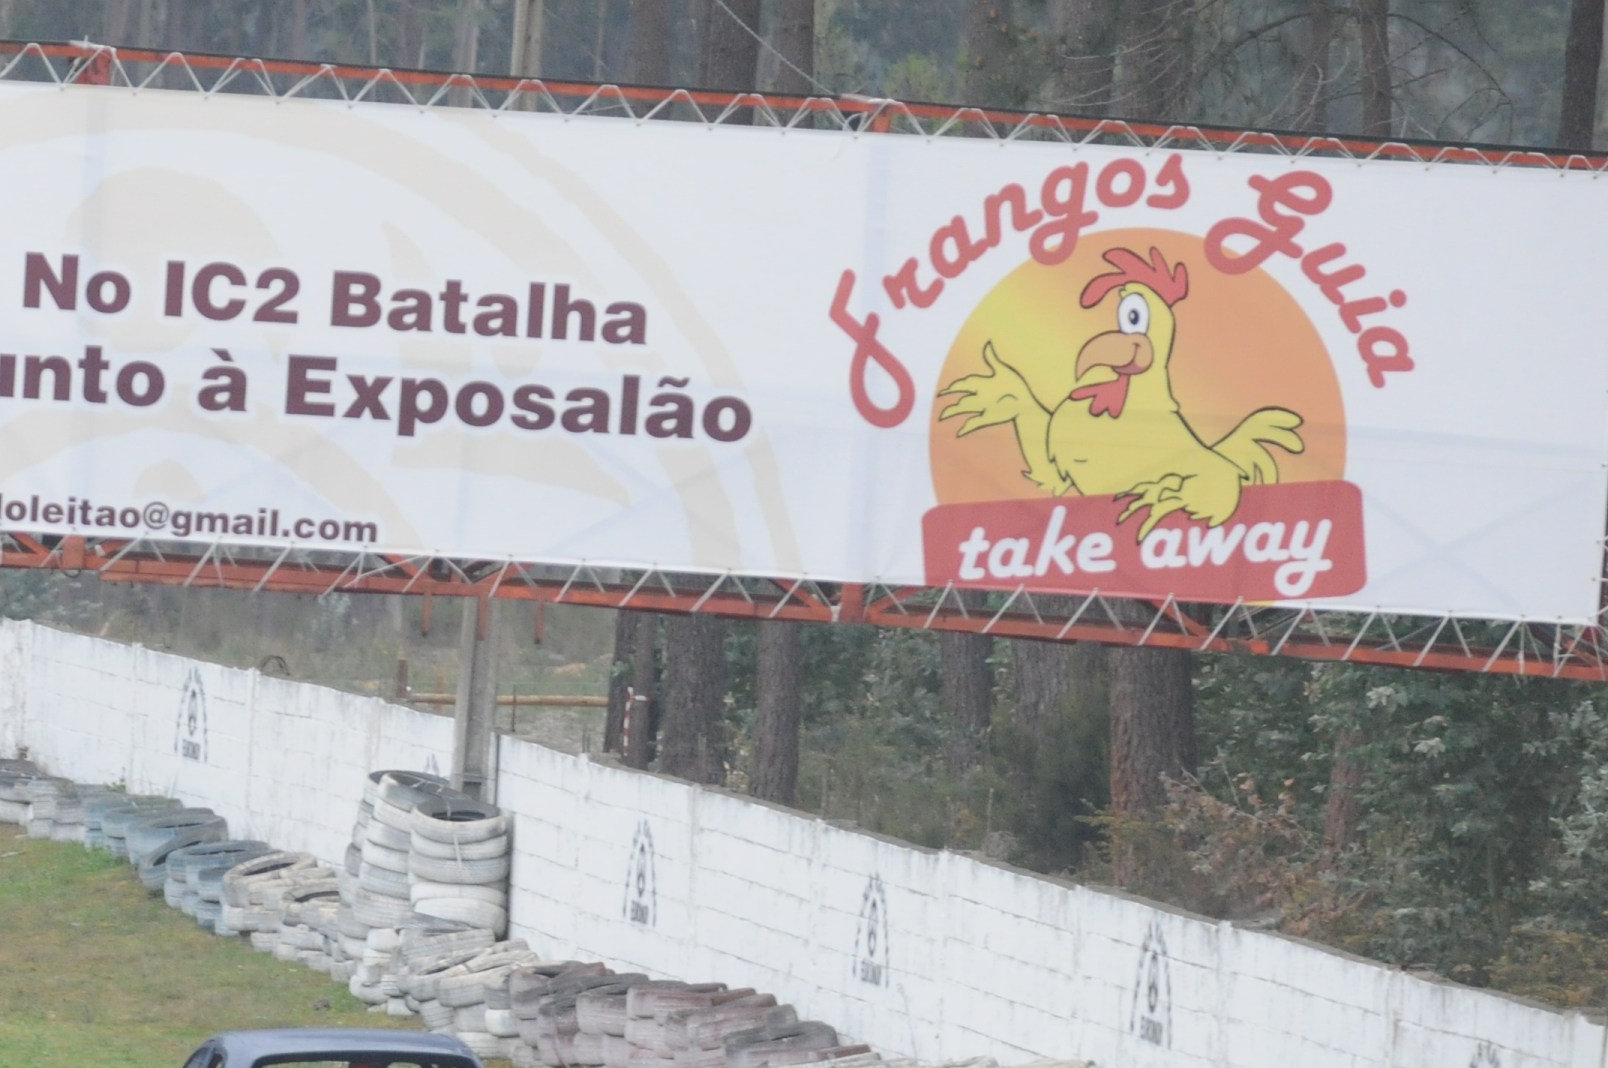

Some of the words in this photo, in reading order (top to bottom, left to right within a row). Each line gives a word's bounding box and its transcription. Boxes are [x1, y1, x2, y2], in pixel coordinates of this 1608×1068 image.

[24, 252, 131, 314] No
[165, 261, 300, 324] IC2
[331, 271, 646, 344] Batalha
[829, 153, 1191, 429] Frangos
[1203, 170, 1416, 389] Guia
[198, 349, 247, 411] à
[285, 355, 752, 442] Exposalão
[958, 505, 1116, 581] take
[1140, 517, 1332, 597] away
